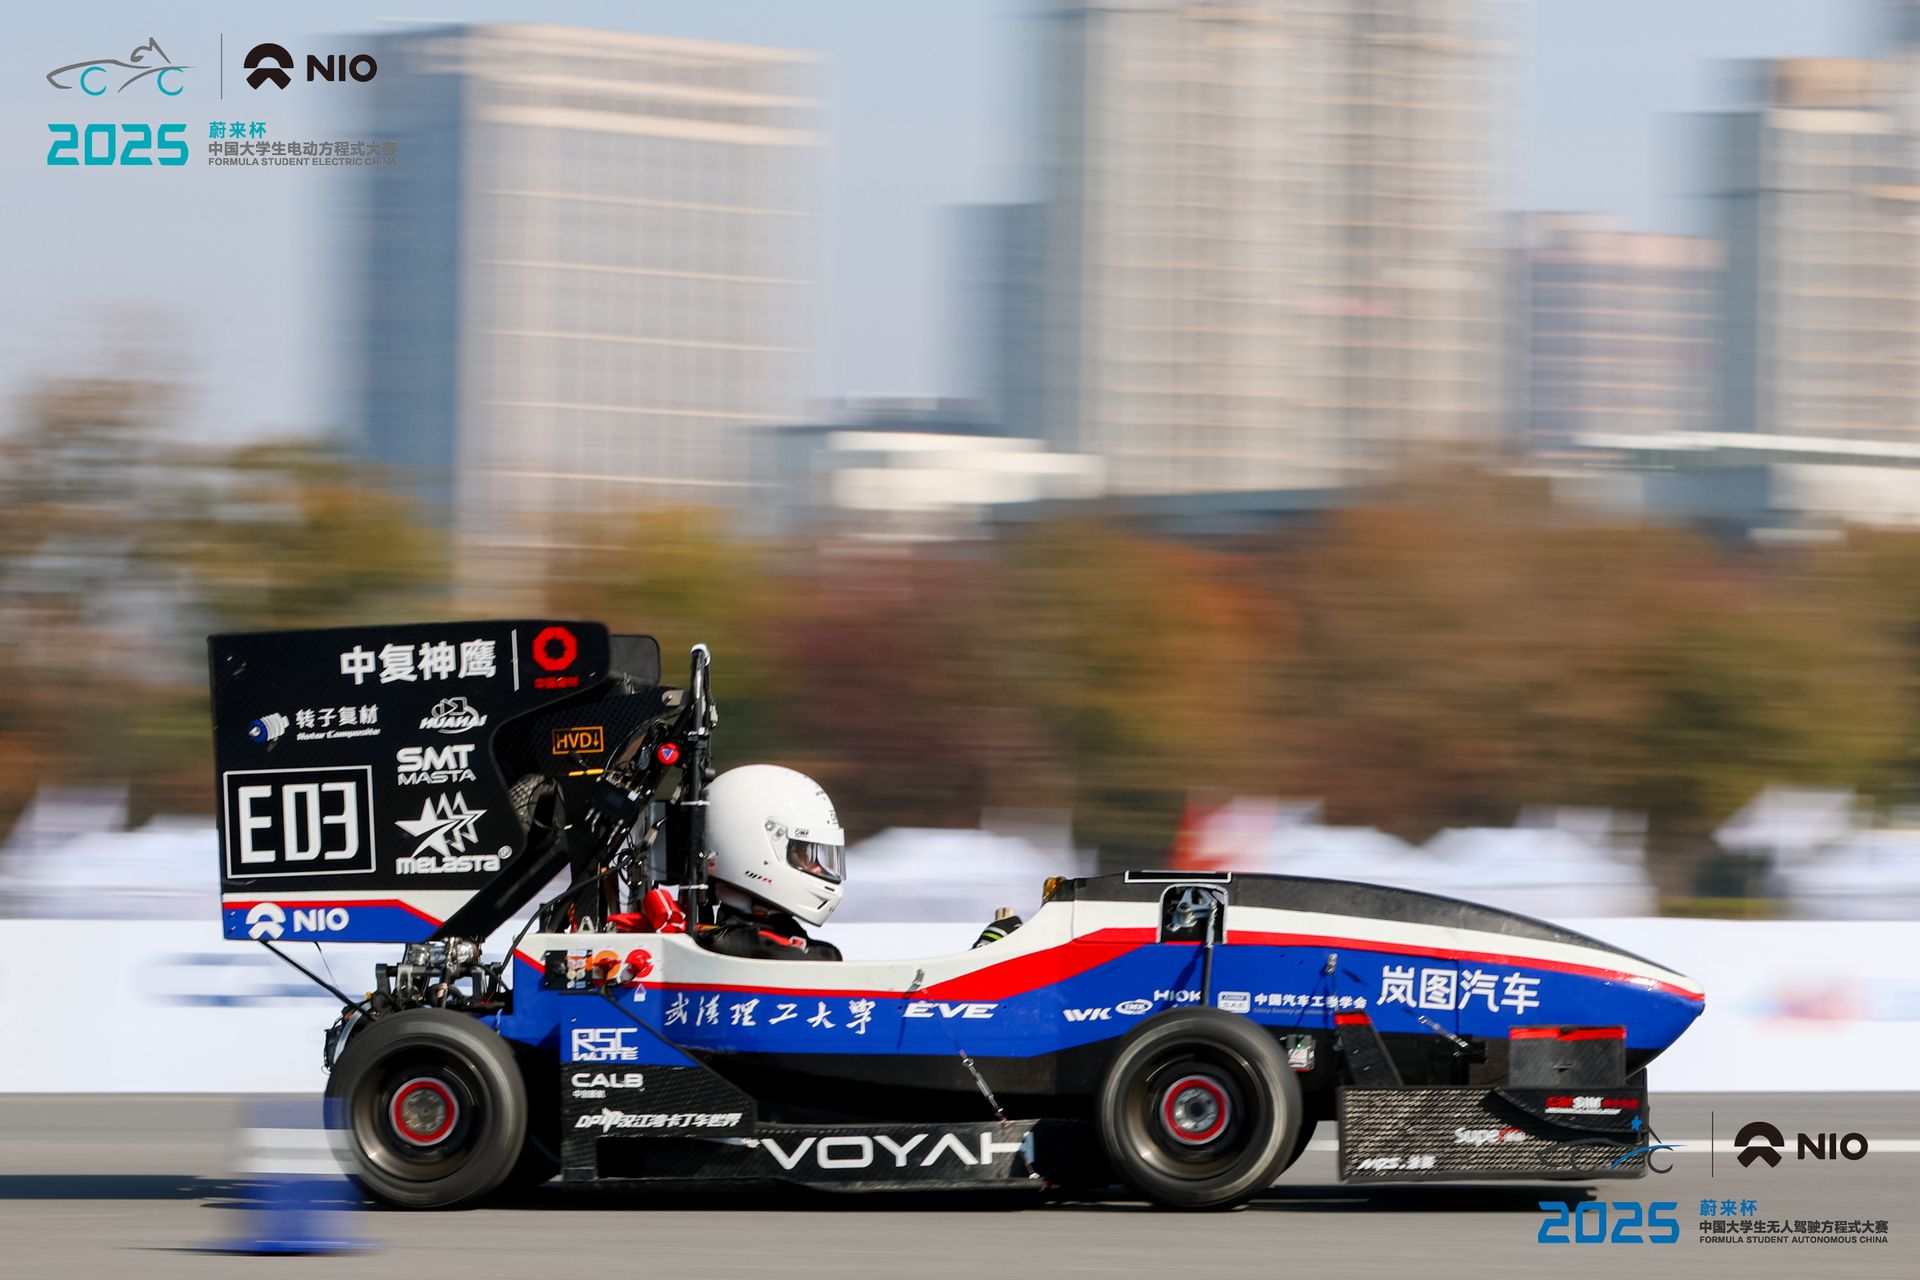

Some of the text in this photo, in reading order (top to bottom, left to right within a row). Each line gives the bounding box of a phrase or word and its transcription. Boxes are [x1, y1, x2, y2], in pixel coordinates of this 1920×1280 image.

[340, 638, 497, 685] 中复神鹰
[295, 704, 379, 729] 转子复材
[556, 732, 592, 749] HVD
[396, 743, 476, 773] SMT
[397, 768, 477, 786] MASTA
[293, 907, 350, 932] NIO
[1376, 964, 1541, 1015] 岚图汽车
[901, 1001, 999, 1019] EVE
[571, 1073, 644, 1088] CALB
[758, 1131, 1035, 1171] VOYAH
